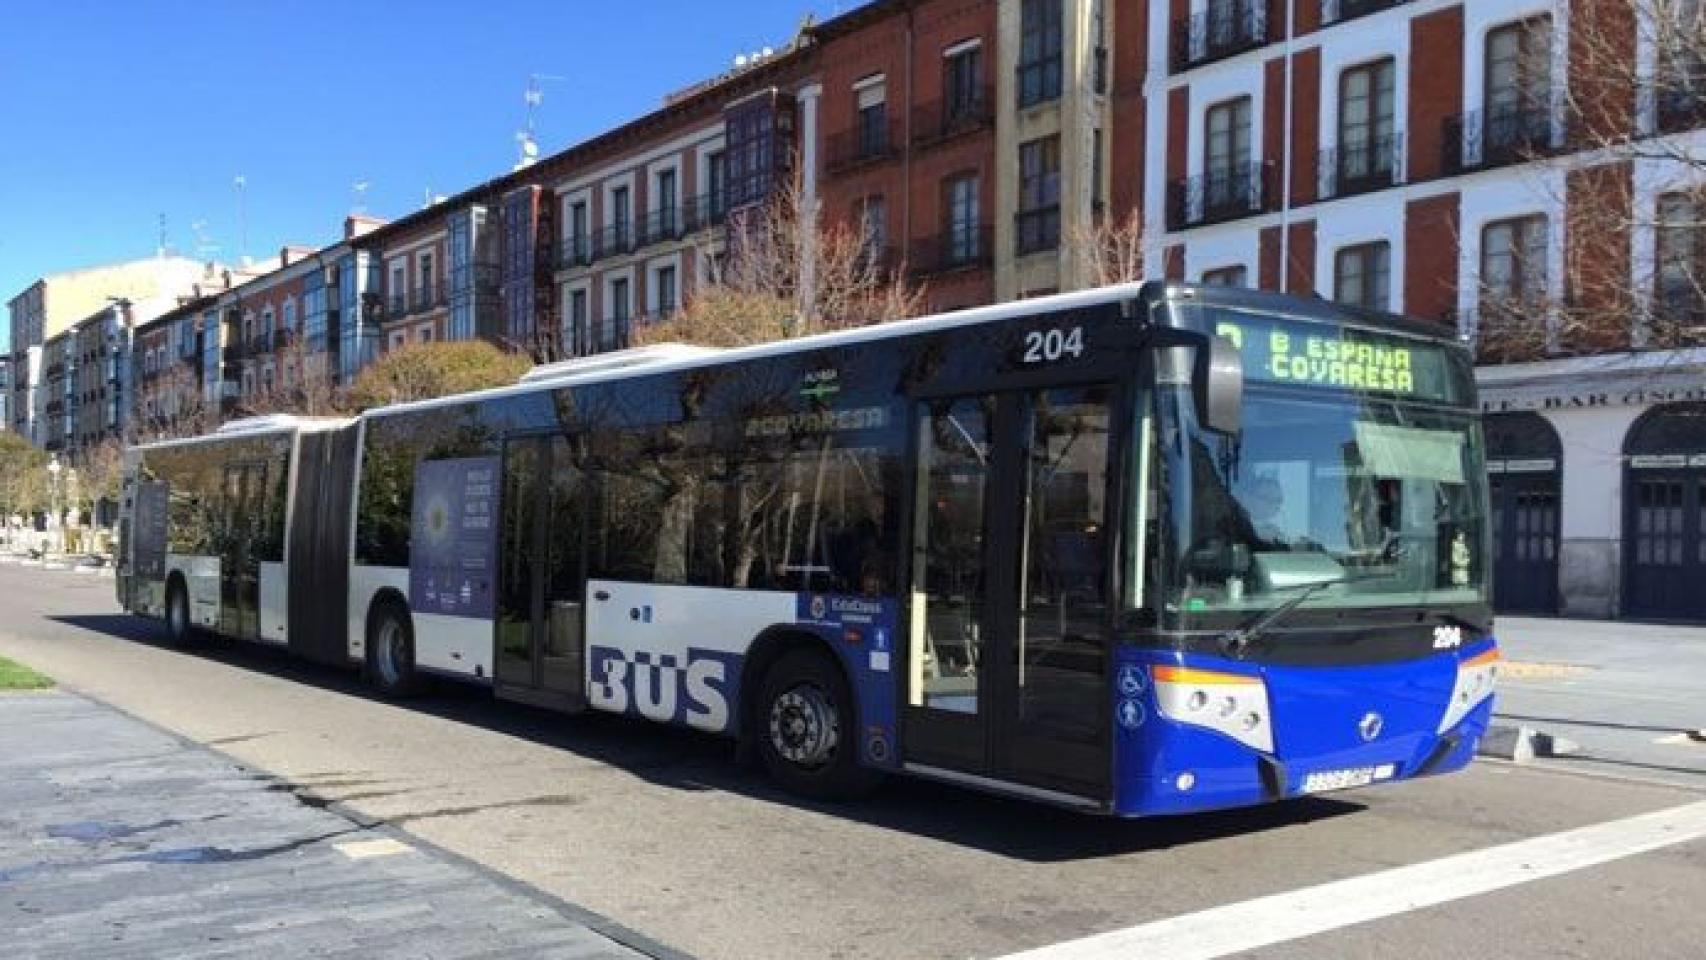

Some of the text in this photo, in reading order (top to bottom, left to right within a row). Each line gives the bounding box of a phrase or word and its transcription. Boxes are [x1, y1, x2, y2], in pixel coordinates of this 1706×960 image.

[1024, 327, 1083, 363] 204
[1272, 354, 1413, 392] COVARESA
[1545, 391, 1609, 410] BAR
[1433, 624, 1460, 648] 204
